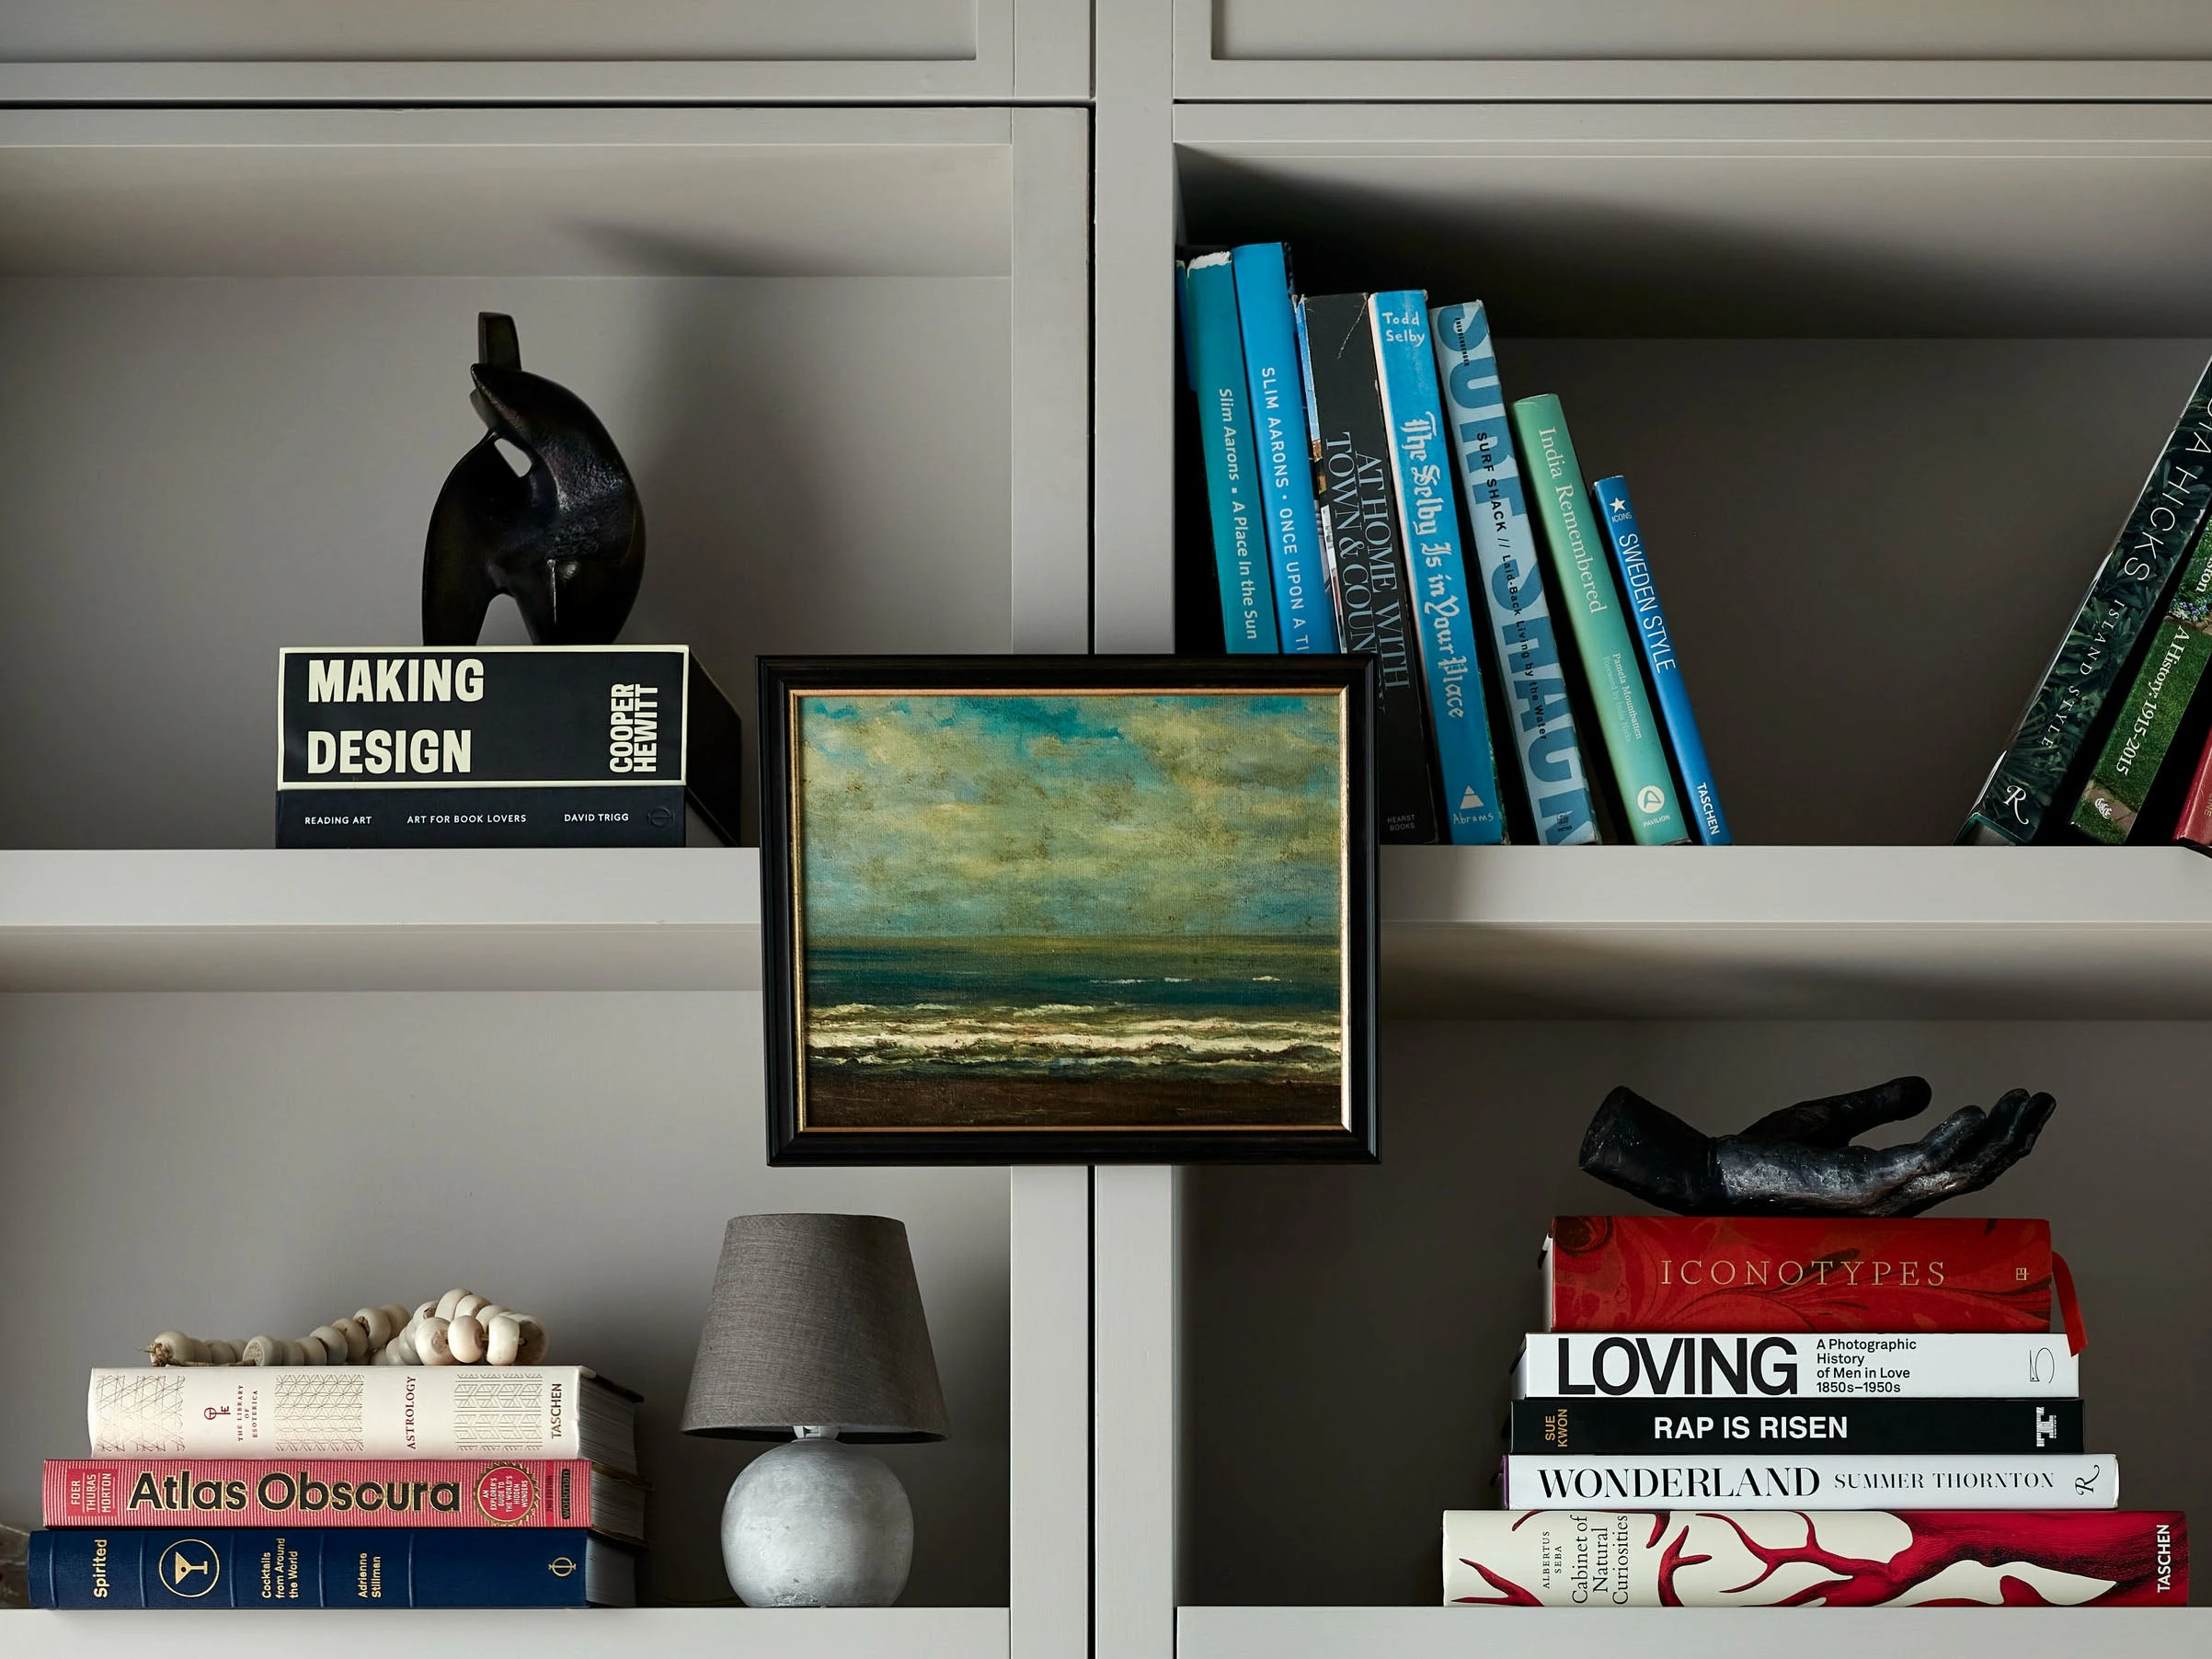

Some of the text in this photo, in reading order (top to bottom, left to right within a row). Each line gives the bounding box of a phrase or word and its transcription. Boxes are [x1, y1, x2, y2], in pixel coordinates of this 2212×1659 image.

[1382, 311, 1420, 326] Todd
[1386, 329, 1426, 348] Selby
[1219, 388, 1234, 422] Slim
[1261, 368, 1279, 409] SLIM
[1223, 426, 1240, 481] Aarons
[1268, 417, 1289, 488] AARONS
[1476, 432, 1495, 473] SURF
[1325, 431, 1362, 531] TOWN
[1232, 501, 1245, 513] A
[1486, 478, 1507, 532] SHACK
[1539, 427, 1608, 614] India Remembered
[1611, 512, 1633, 522] ICONS
[2124, 465, 2198, 581] HICKS
[1234, 513, 1248, 556] Place
[1279, 508, 1298, 555] ONCE
[1338, 536, 1365, 558] &
[1286, 561, 1304, 611] UPON
[1355, 451, 1410, 689] AT HOME WITH
[1400, 411, 1469, 719] The Selby Is in Your Place
[1502, 555, 1521, 616] Laid-Back
[1241, 579, 1254, 605] the
[1619, 533, 1676, 674] SWEDEN STYLE
[1244, 610, 1257, 639] Sun
[1292, 618, 1306, 629] A
[1516, 620, 1530, 660] Living
[307, 658, 485, 703] MAKING
[1524, 664, 1533, 677] by
[1529, 681, 1539, 701] the
[2041, 599, 2125, 749] ISLAND STYLE
[1612, 652, 1642, 738] Pamela Mountbatten
[2116, 624, 2190, 776] A History: 1915-2015
[609, 683, 635, 773] COOPER
[633, 683, 659, 772] HEWITT
[1533, 704, 1547, 739] Water
[306, 729, 472, 774] DESIGN
[304, 817, 372, 826] READING ART
[407, 814, 527, 824] ART FOR BOOK LOVERS
[564, 813, 629, 822] DAVID TRIGG
[1387, 814, 1415, 823] HEARST
[1452, 812, 1494, 825] Abrams
[1643, 815, 1670, 828] PAVILION
[1697, 782, 1720, 836] TASCHEN
[1661, 1260, 1945, 1287] ICONOTYPES
[1558, 1337, 1798, 1395] LOVING
[1817, 1339, 1917, 1353] A Photographic
[1817, 1354, 1864, 1367] History
[1817, 1367, 1911, 1379] of Men in Love
[245, 1407, 250, 1419] OF
[405, 1376, 417, 1449] ASTROLOGY
[551, 1382, 562, 1439] TASCHEN
[1545, 1415, 1555, 1441] SUE
[1557, 1408, 1568, 1447] KWON
[1654, 1416, 1847, 1439] RAP IS RISEN
[71, 1480, 80, 1506] FOER
[86, 1473, 97, 1513] THURAS
[101, 1472, 111, 1514] MORTON
[127, 1470, 460, 1513] Atlas Obscura
[482, 1490, 489, 1499] AN
[489, 1477, 498, 1511] EXPLORER'S
[562, 1470, 570, 1518] workman
[1537, 1467, 2054, 1499] WONDERLAND SUMMER THORNTON
[93, 1539, 109, 1598] Spirited
[261, 1551, 271, 1599] Cocktails
[275, 1538, 285, 1599] from Around
[289, 1550, 298, 1599] the World
[358, 1552, 368, 1598] Adrienne
[372, 1556, 381, 1599] Stillman
[1570, 1515, 1588, 1604] Cabinet of
[1591, 1526, 1609, 1593] Natural
[1612, 1515, 1628, 1606] Curiosities
[2157, 1525, 2171, 1593] TASCHEN
